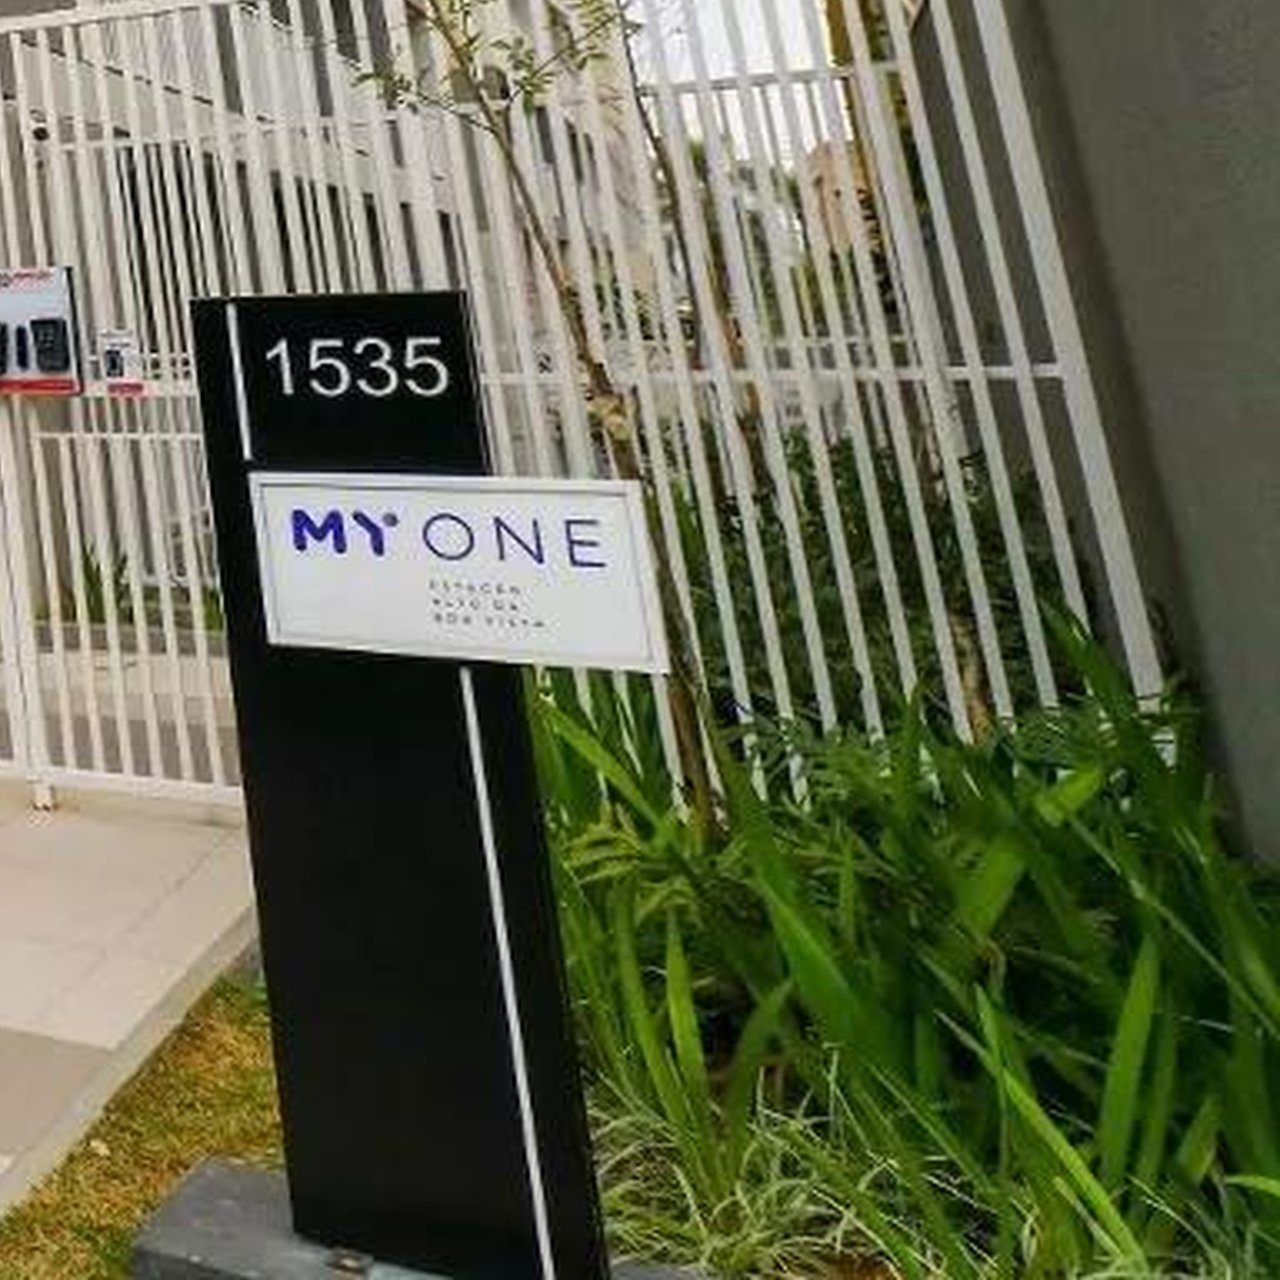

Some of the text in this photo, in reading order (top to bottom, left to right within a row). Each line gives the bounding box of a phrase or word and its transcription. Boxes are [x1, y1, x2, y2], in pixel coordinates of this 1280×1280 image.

[265, 336, 449, 397] 1535
[290, 508, 607, 568] MY ONE
